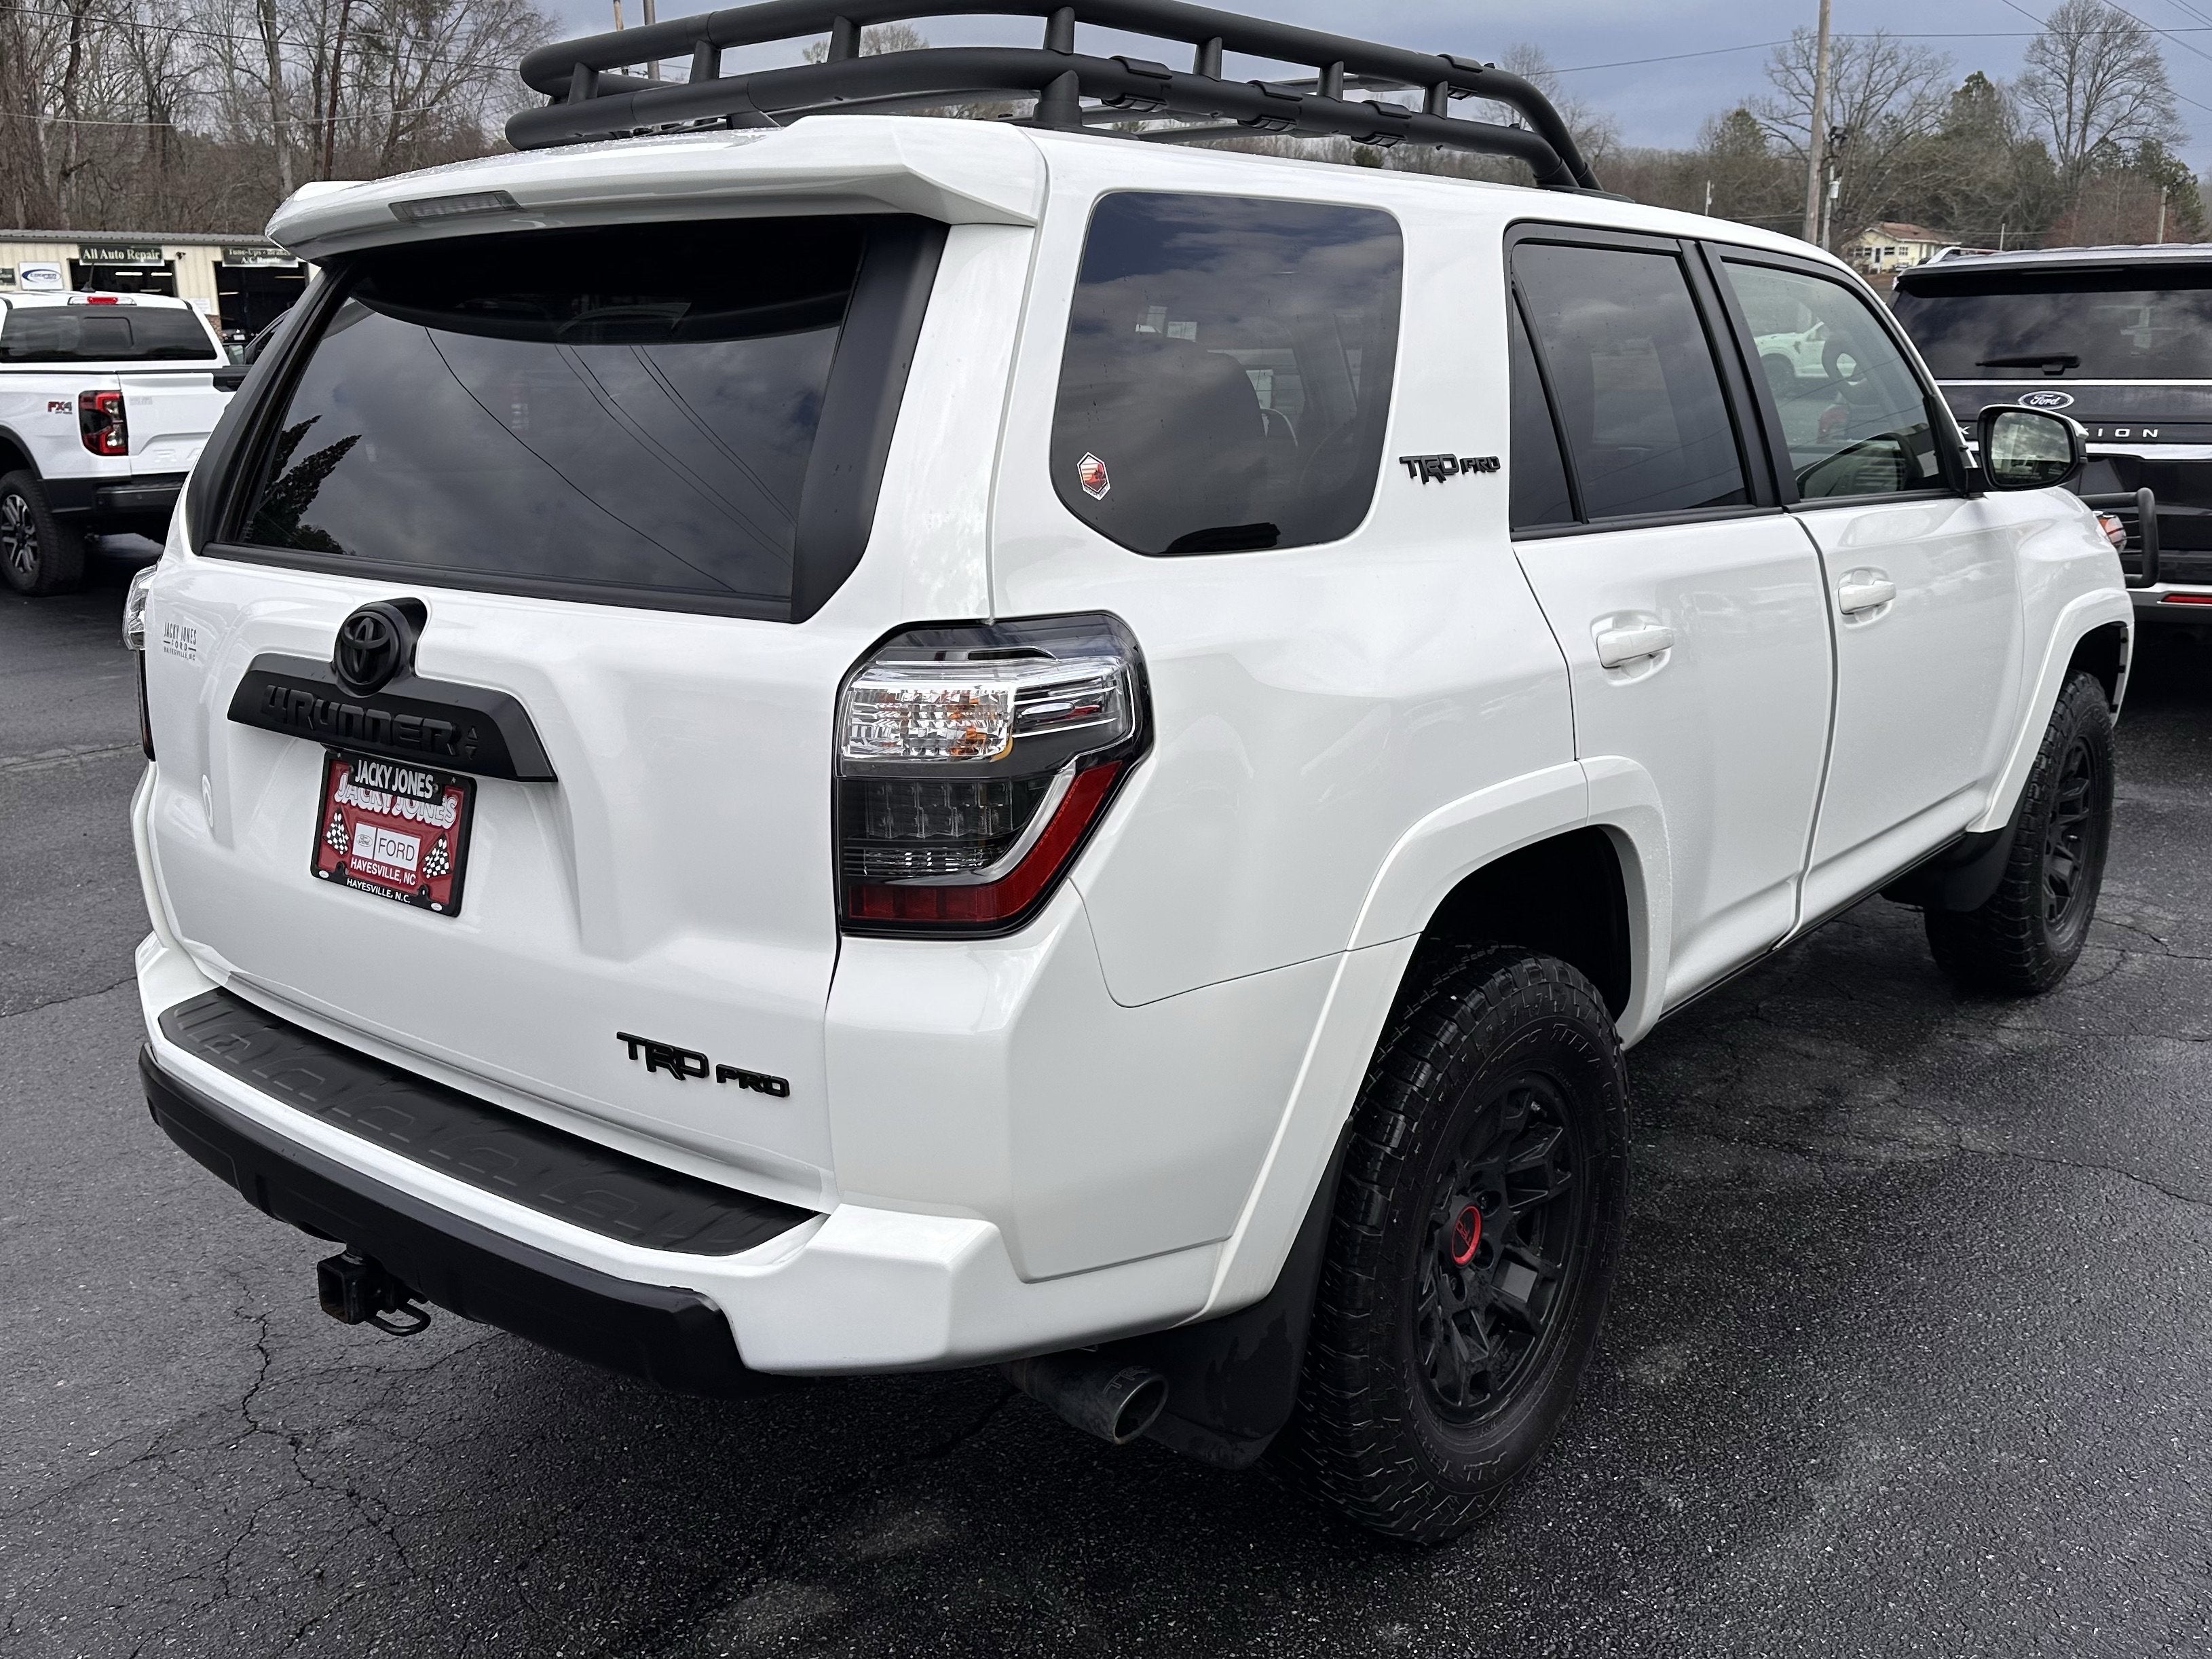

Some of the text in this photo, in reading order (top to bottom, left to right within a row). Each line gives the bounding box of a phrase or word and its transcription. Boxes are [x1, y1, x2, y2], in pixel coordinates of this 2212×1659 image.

[83, 248, 160, 262] All Auto Repair
[48, 401, 72, 412] FX4
[2030, 394, 2061, 405] Ford
[1399, 453, 1501, 485] TRD PRO
[164, 622, 197, 646] JACKY JONES
[171, 639, 187, 652] FORD
[262, 684, 458, 756] 4RUNNER
[355, 759, 434, 800] JACKY JONES
[377, 836, 415, 861] FORD
[350, 857, 402, 884] HAYESVILLE,
[403, 872, 417, 886] NC
[346, 878, 411, 903] HAYESVILLE, N.C.
[616, 1031, 791, 1098] TRD PRO
